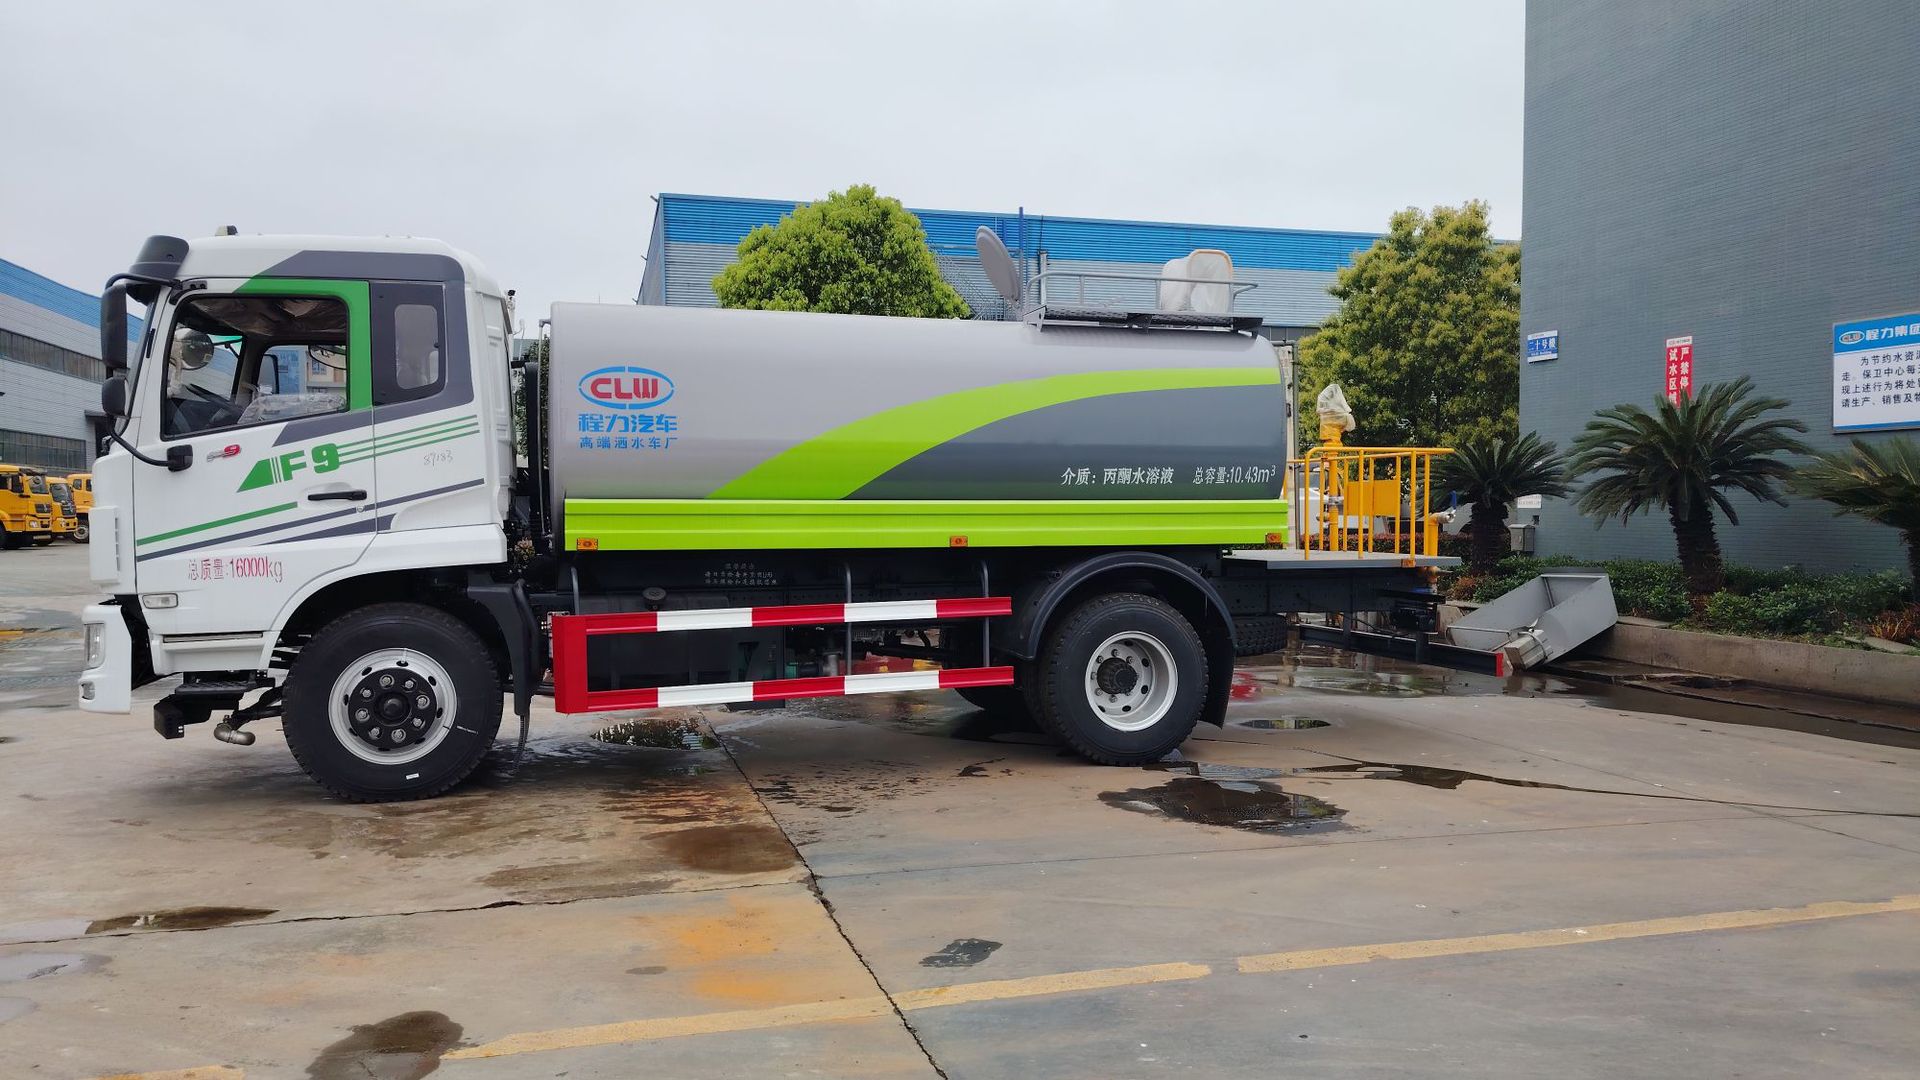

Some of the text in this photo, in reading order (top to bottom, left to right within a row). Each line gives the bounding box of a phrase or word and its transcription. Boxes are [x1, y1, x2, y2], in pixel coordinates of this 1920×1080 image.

[590, 377, 659, 400] CLW
[1841, 378, 1920, 396] 现上述行为将处
[578, 413, 679, 433] 程力汽车
[579, 436, 678, 450] 高端洒水车厂
